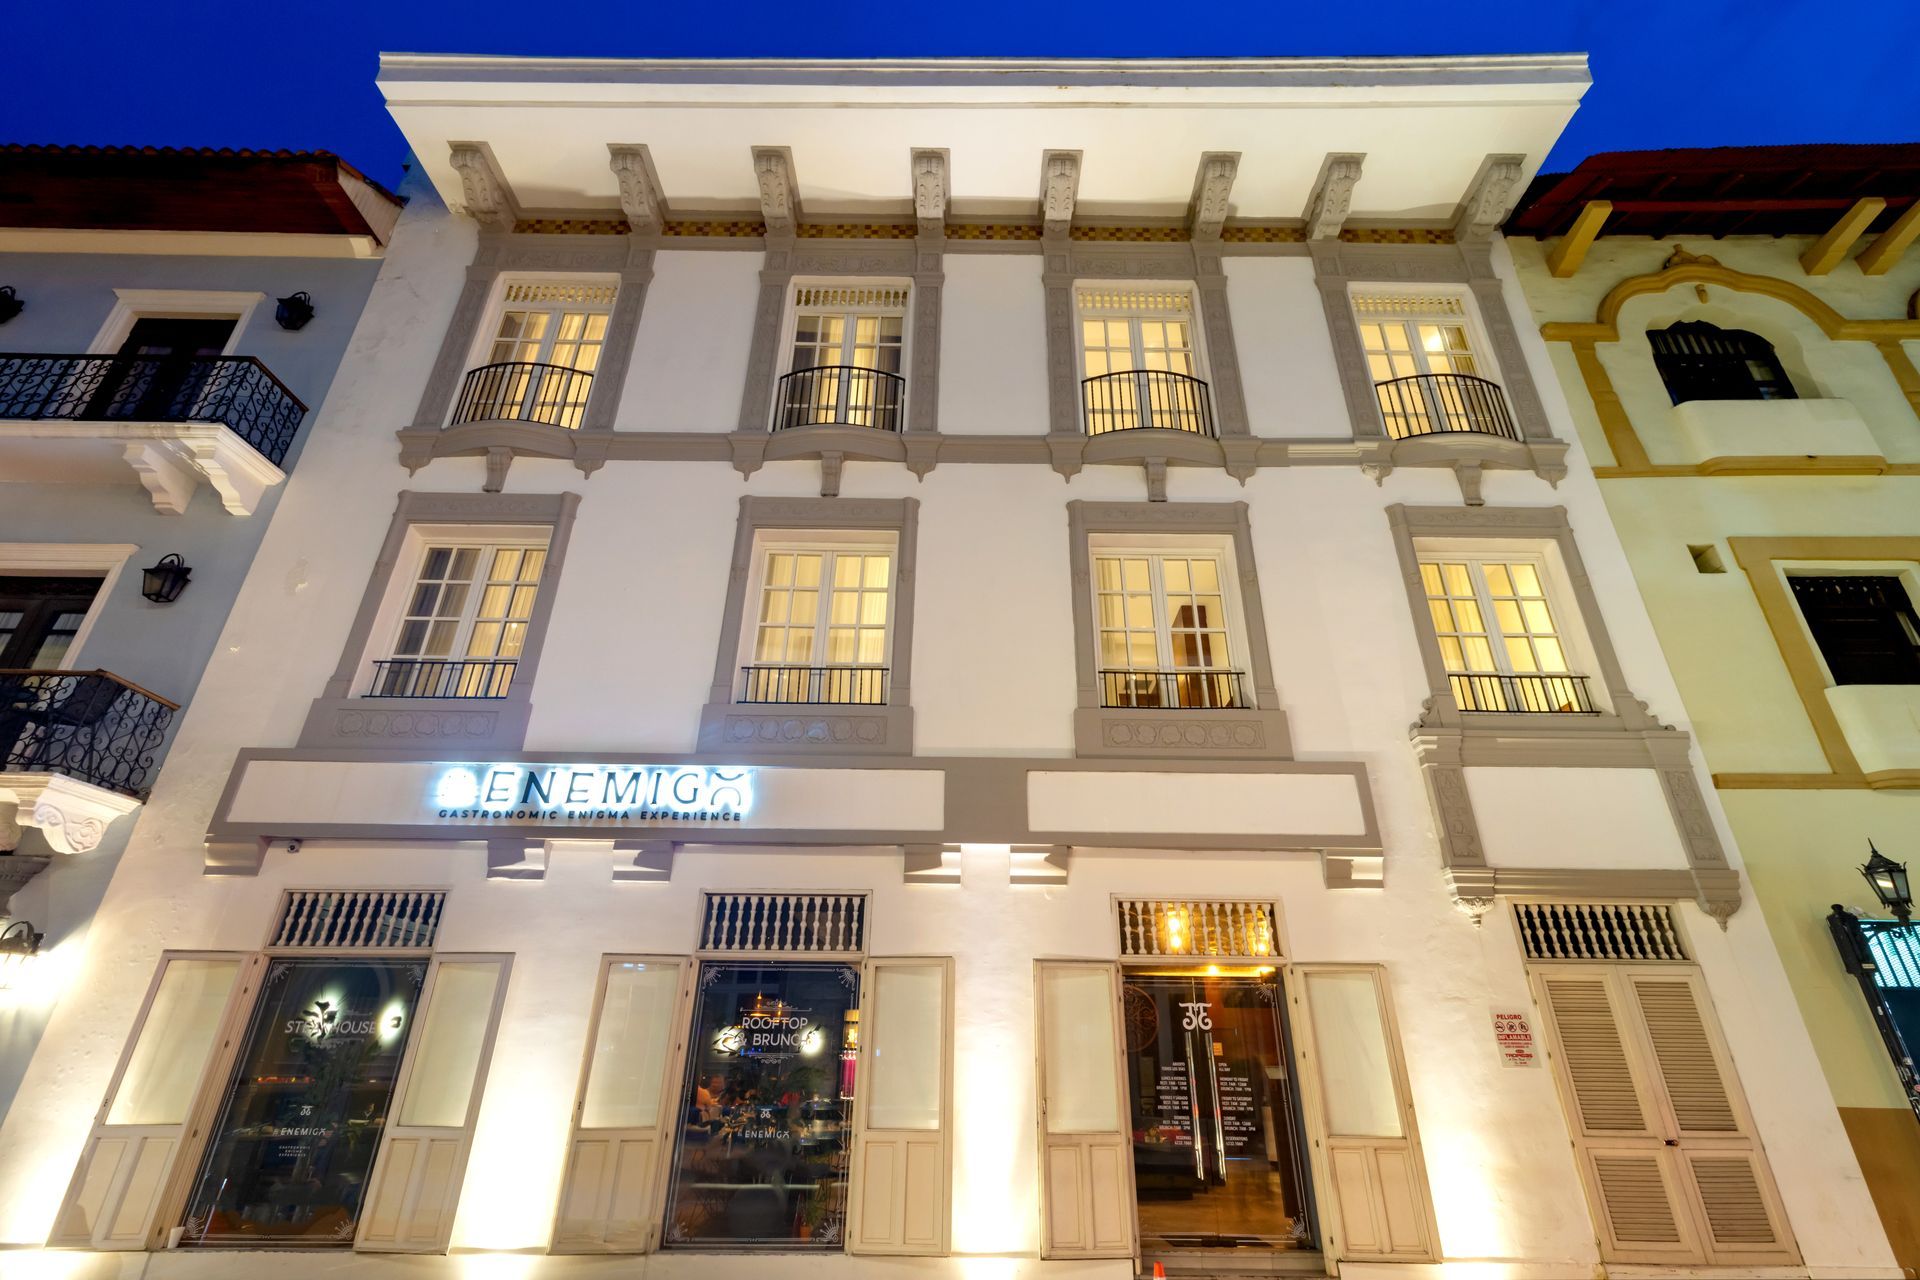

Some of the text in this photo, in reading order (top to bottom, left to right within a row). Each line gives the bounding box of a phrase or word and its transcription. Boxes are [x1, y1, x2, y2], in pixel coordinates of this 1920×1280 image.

[439, 809, 742, 822] GASTRONOMIC ENIGMA EXPERIENCE
[742, 1017, 808, 1029] ROOFTOP
